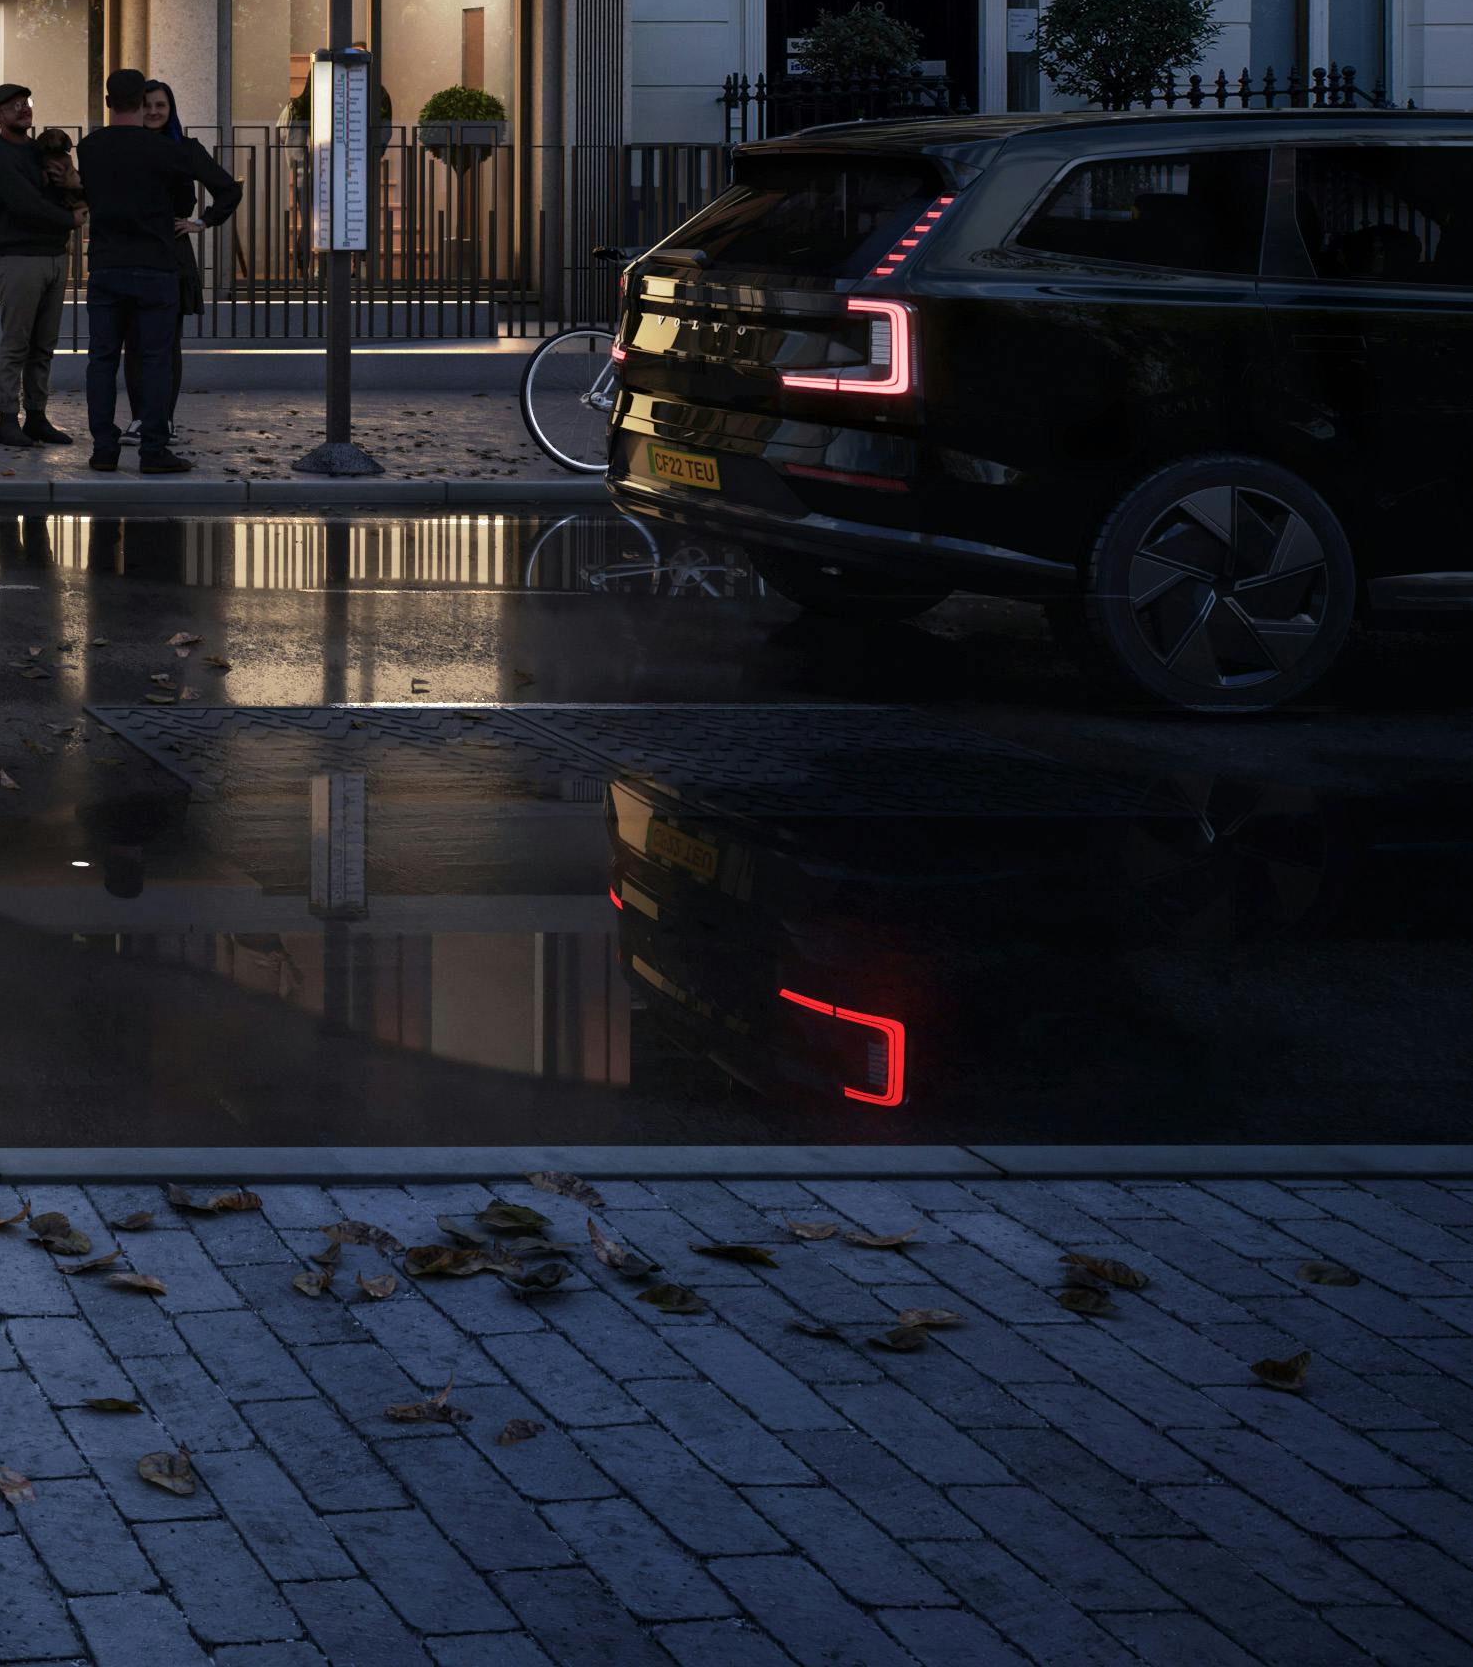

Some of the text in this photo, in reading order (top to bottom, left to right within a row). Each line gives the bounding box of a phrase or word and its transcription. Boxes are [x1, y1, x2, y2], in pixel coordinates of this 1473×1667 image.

[657, 314, 747, 336] VOLVO
[655, 452, 715, 483] CF22 TEU
